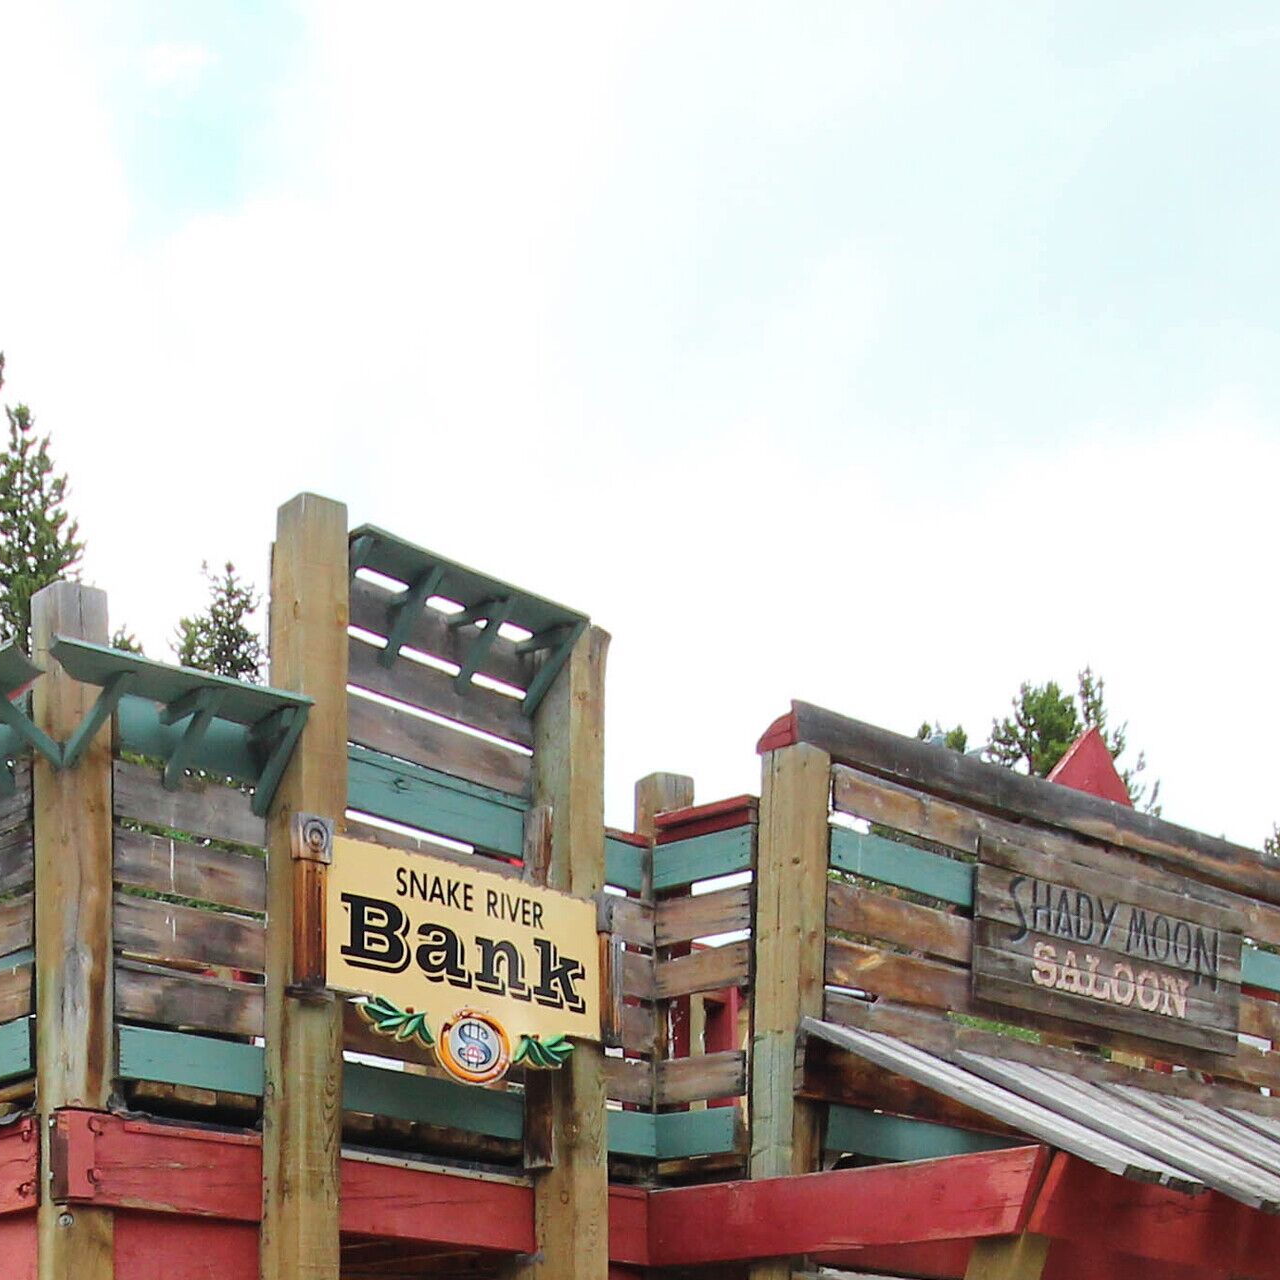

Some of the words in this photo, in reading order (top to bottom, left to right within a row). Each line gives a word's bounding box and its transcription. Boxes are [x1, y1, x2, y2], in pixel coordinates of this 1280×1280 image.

[396, 867, 473, 912] SNAKE
[487, 889, 544, 929] RIVER
[1008, 876, 1120, 944] SHADY
[1126, 908, 1220, 993] MOON
[341, 892, 585, 1014] Bank
[1031, 942, 1189, 1019] SALOON
